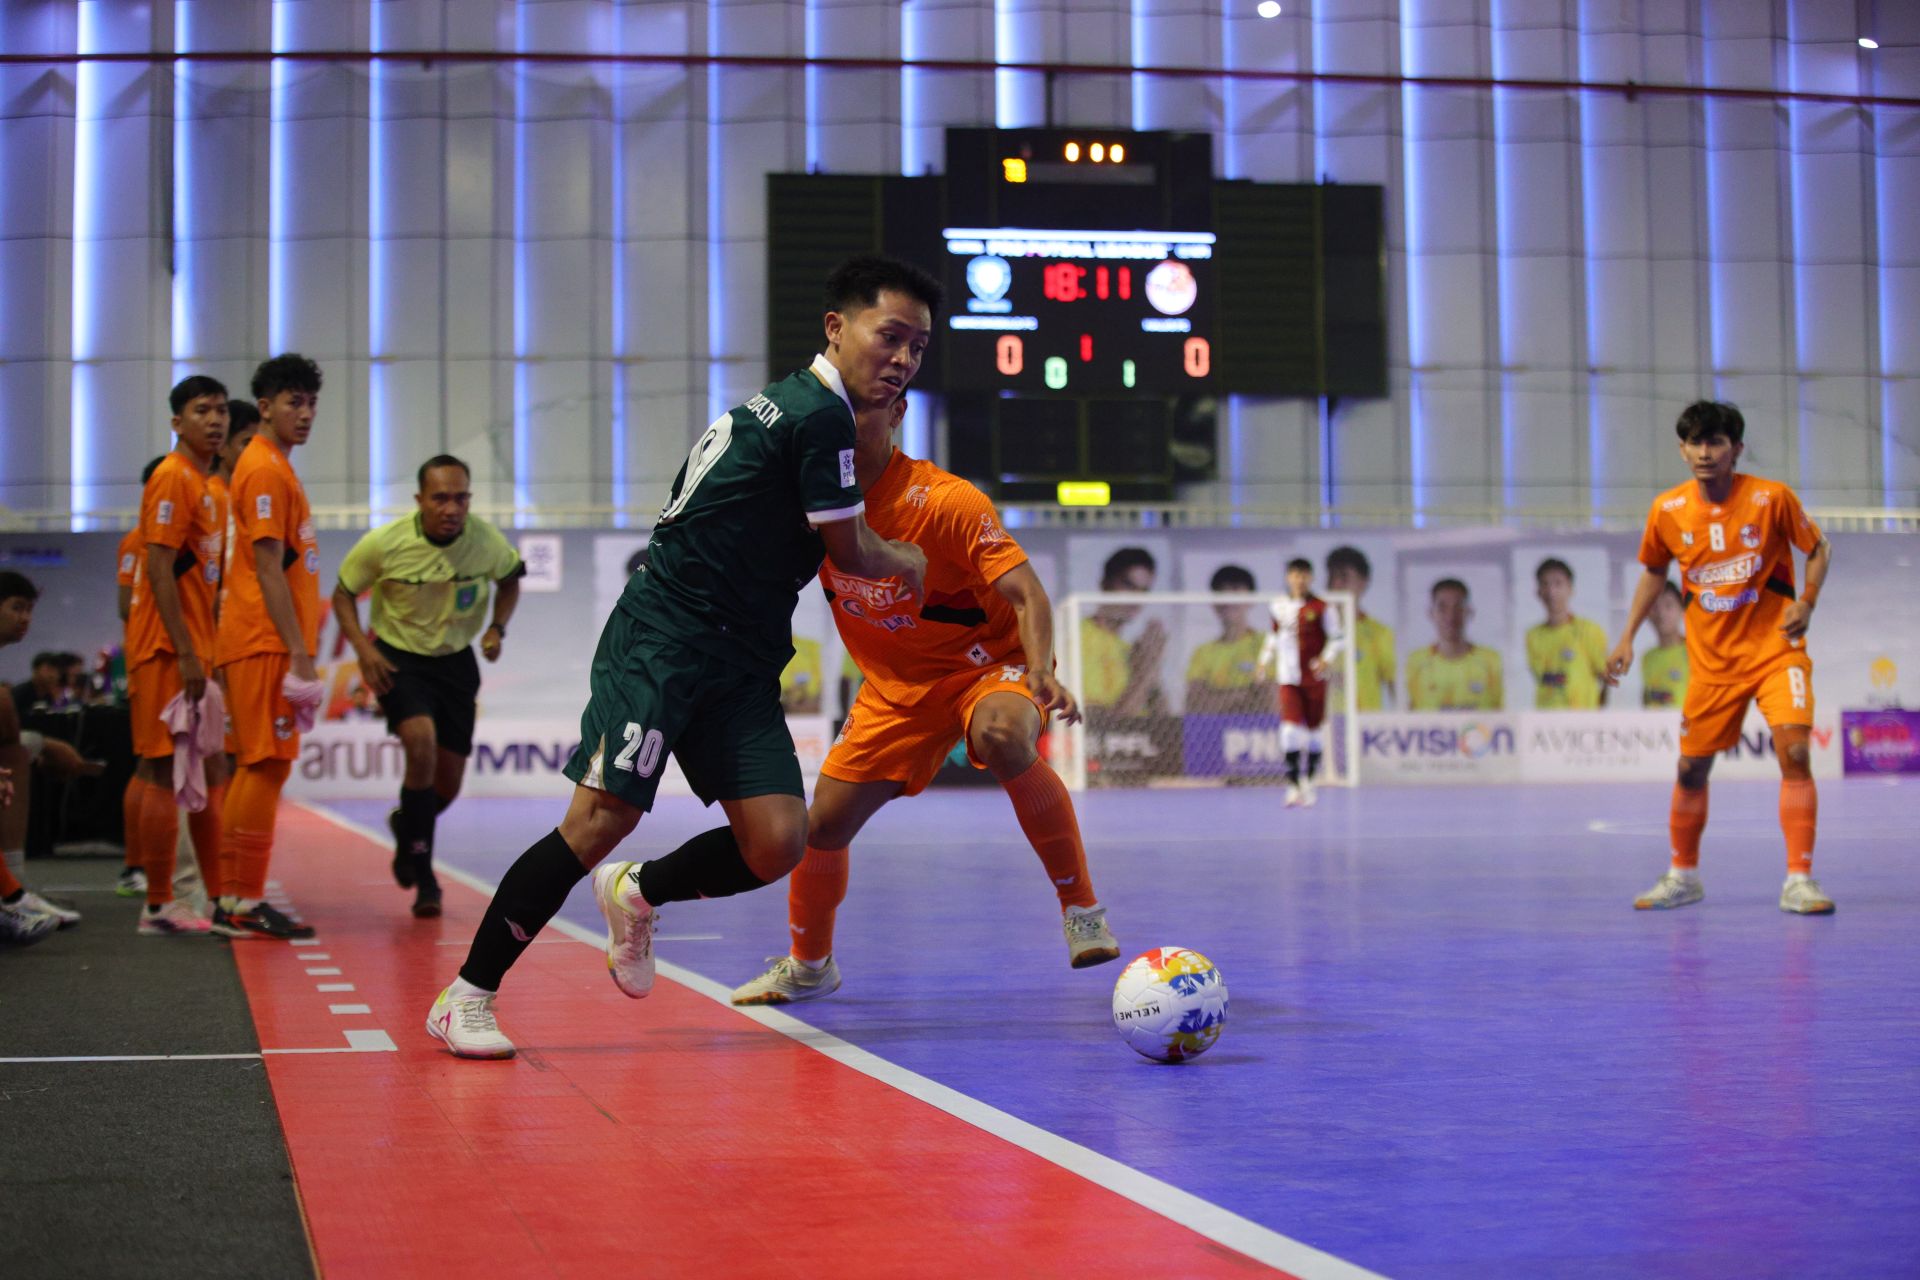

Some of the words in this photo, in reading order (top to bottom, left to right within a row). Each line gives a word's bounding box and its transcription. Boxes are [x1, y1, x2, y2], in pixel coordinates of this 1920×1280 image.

[996, 335, 1023, 375] 0
[1184, 337, 1210, 377] 0
[614, 721, 664, 778] 20
